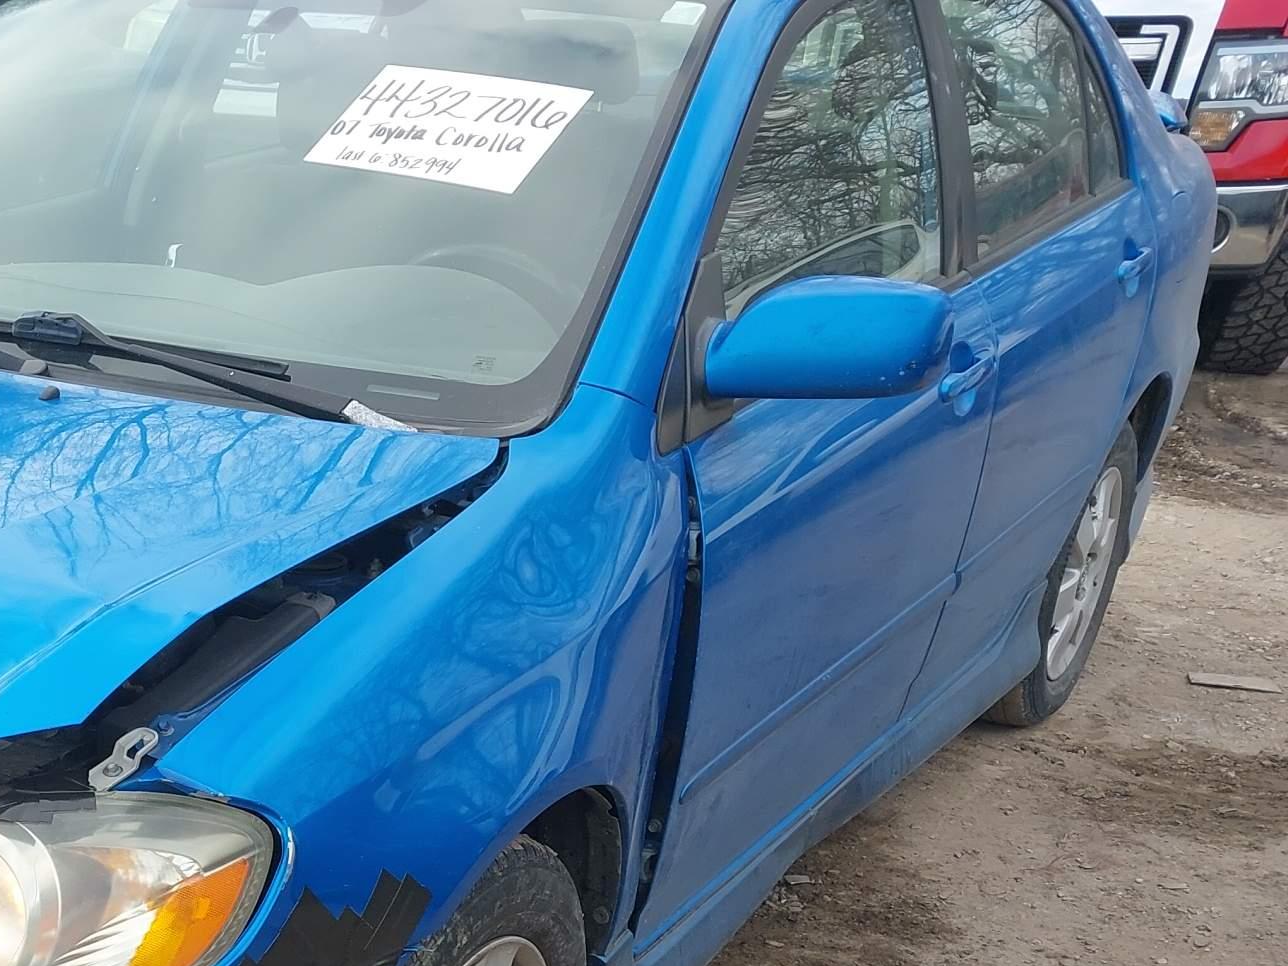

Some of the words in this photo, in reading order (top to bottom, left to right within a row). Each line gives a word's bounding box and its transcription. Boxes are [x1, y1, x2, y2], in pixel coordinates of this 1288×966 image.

[330, 119, 362, 136] 07
[368, 121, 428, 145] Toyota
[435, 126, 525, 152] Corolla
[388, 152, 463, 175] 852994
